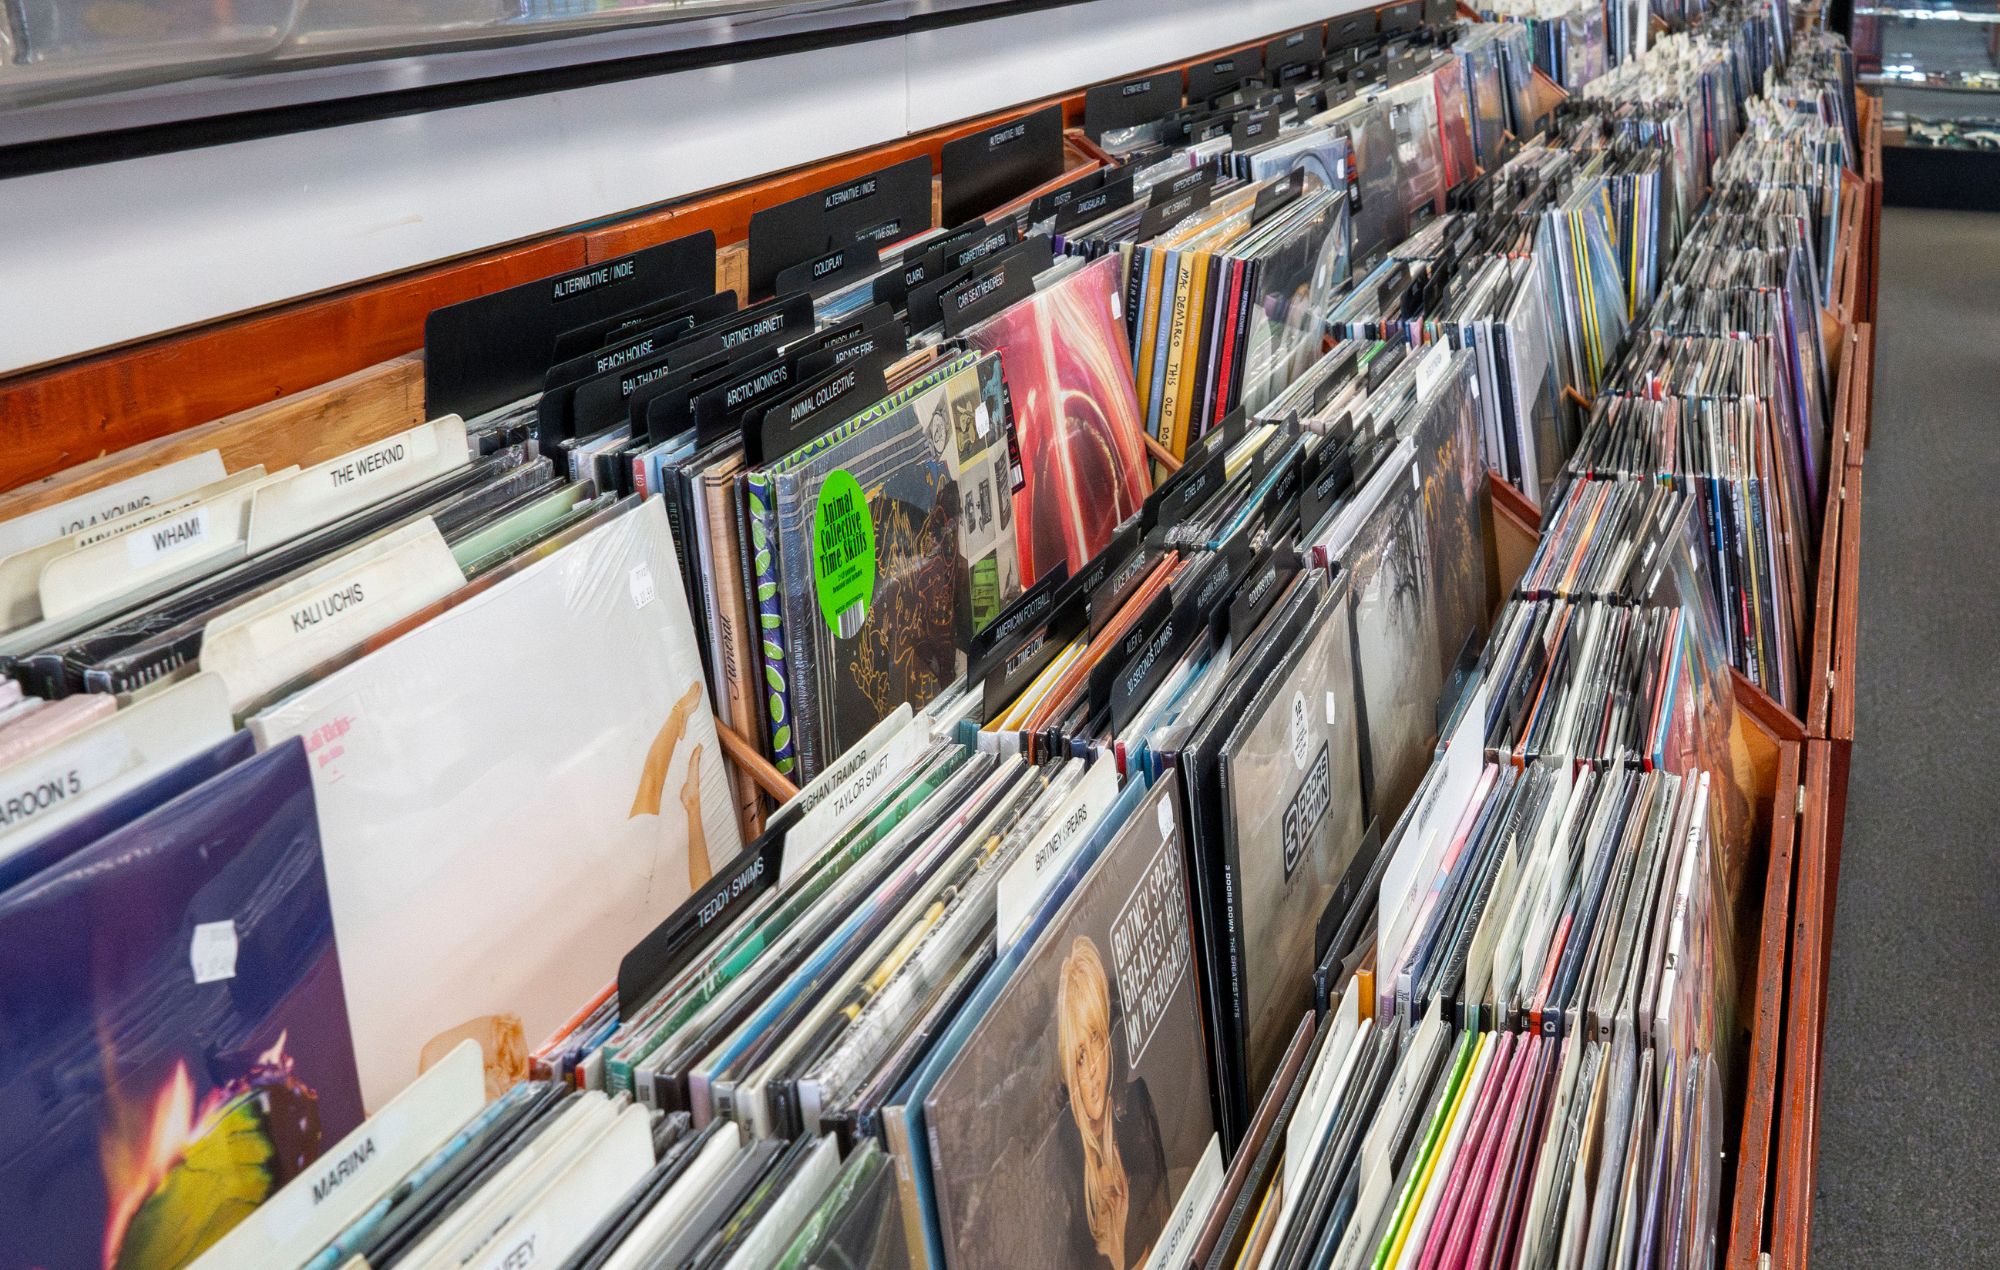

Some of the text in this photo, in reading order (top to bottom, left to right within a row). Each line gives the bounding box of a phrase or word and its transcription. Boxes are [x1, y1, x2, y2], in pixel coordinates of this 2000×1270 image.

[825, 186, 859, 208] ALTERNATIVE
[862, 179, 876, 196] INDIE
[554, 268, 608, 298] ALTERNATIVE
[613, 260, 634, 279] INDIE
[813, 253, 843, 277] COLDPLAY
[905, 267, 924, 285] CLAIRO
[1179, 268, 1189, 289] MAC
[957, 293, 969, 310] CAR
[967, 283, 982, 303] SEAT
[979, 272, 1006, 298] HEADREST
[753, 313, 784, 338] BARNETT
[1173, 296, 1187, 348] DEMARCO
[597, 340, 654, 373] BEACH HOUSE
[1167, 363, 1178, 386] THIS
[727, 384, 753, 408] ARCTIC
[753, 366, 788, 392] MONKEYS
[791, 372, 855, 423] ANIMAL COLLECTIVE
[1164, 397, 1173, 417] OLD
[330, 443, 405, 489] THE WEEKND
[822, 488, 855, 528] Animal
[153, 516, 201, 551] WHAM!
[820, 510, 863, 554] Collective
[819, 547, 843, 579] Time
[842, 530, 869, 566] Skiffs
[290, 582, 365, 634] KALI UCHIS
[995, 590, 1051, 642] AMERICAN FOOTBALL
[1006, 633, 1045, 677] ALL TIME LOW
[1126, 628, 1143, 656] ALEX G
[1126, 621, 1173, 696] 30 SECONDS TO MARS
[68, 769, 82, 795] 5
[802, 749, 868, 815] EGHAN TRAINOR
[833, 752, 890, 818] TAYLOR SWIFT
[1300, 755, 1327, 817] DOORS
[1301, 776, 1328, 842] DOWN
[1035, 803, 1088, 872] BRITNEY SPEARS
[1284, 803, 1300, 873] 3
[697, 856, 765, 929] TEDDY SWIMS
[1114, 835, 1179, 971] BRITNEY SPEARS
[1227, 905, 1235, 933] DOWN
[1121, 910, 1168, 1012] GREATEST
[1230, 955, 1239, 998] GREATEST
[1128, 1010, 1143, 1054] MY
[311, 1135, 377, 1206] MARINA
[1170, 1201, 1194, 1256] STYLES
